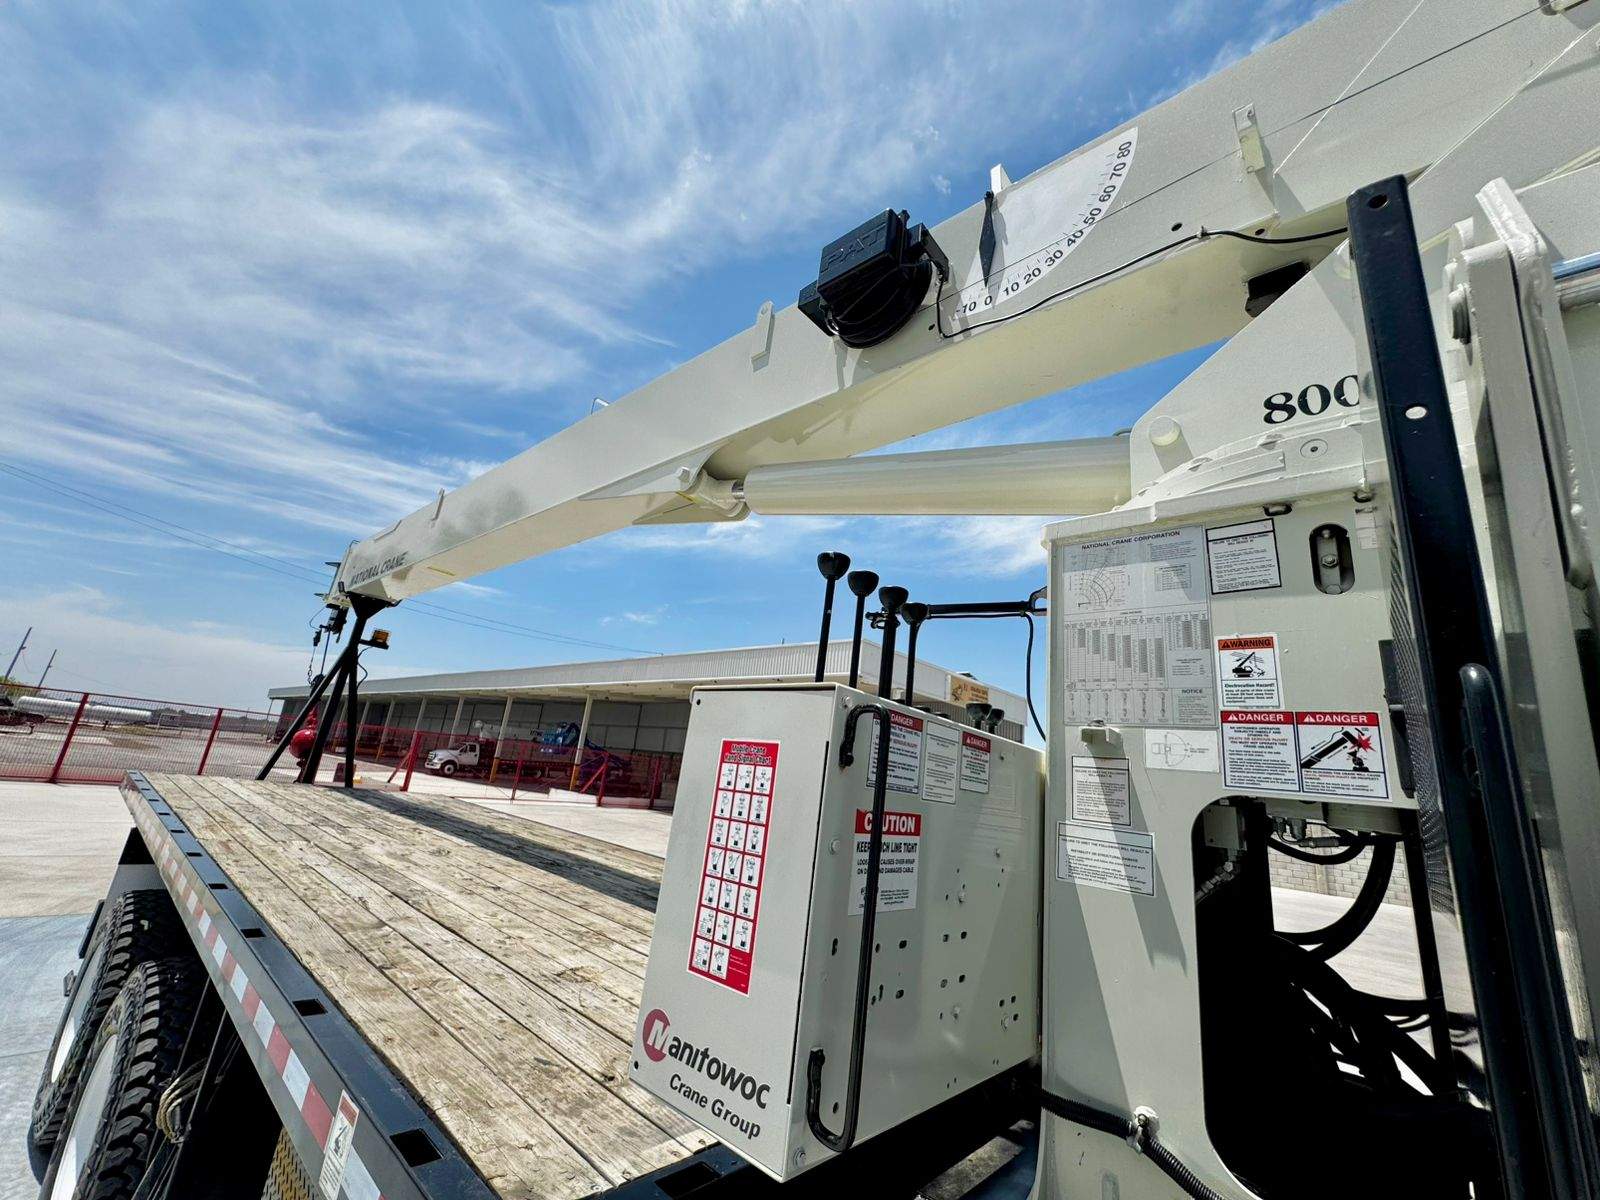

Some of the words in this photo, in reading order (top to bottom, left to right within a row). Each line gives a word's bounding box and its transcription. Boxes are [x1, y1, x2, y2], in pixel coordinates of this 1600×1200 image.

[1116, 141, 1132, 160] 80
[1109, 162, 1127, 181] 70
[1098, 185, 1116, 203] 60
[1083, 207, 1102, 225] 50
[1066, 230, 1084, 247] 40
[1045, 250, 1063, 267] 30
[1023, 267, 1042, 283] 20
[1003, 282, 1020, 296] 10
[956, 301, 976, 314] -10
[984, 295, 993, 306] 0
[1081, 541, 1109, 551] NATIONAL
[1111, 537, 1133, 546] CRANE
[1134, 530, 1181, 543] CORPORATION
[380, 551, 409, 574] CRANE
[1229, 638, 1271, 648] WARNING
[1238, 713, 1285, 722] DANGER
[1315, 714, 1368, 724] DANGER
[864, 813, 915, 833] CUTION
[902, 842, 918, 853] TIGHT
[645, 1017, 771, 1110] Manitowoc
[669, 1073, 708, 1109] Crane
[711, 1098, 761, 1140] Group
